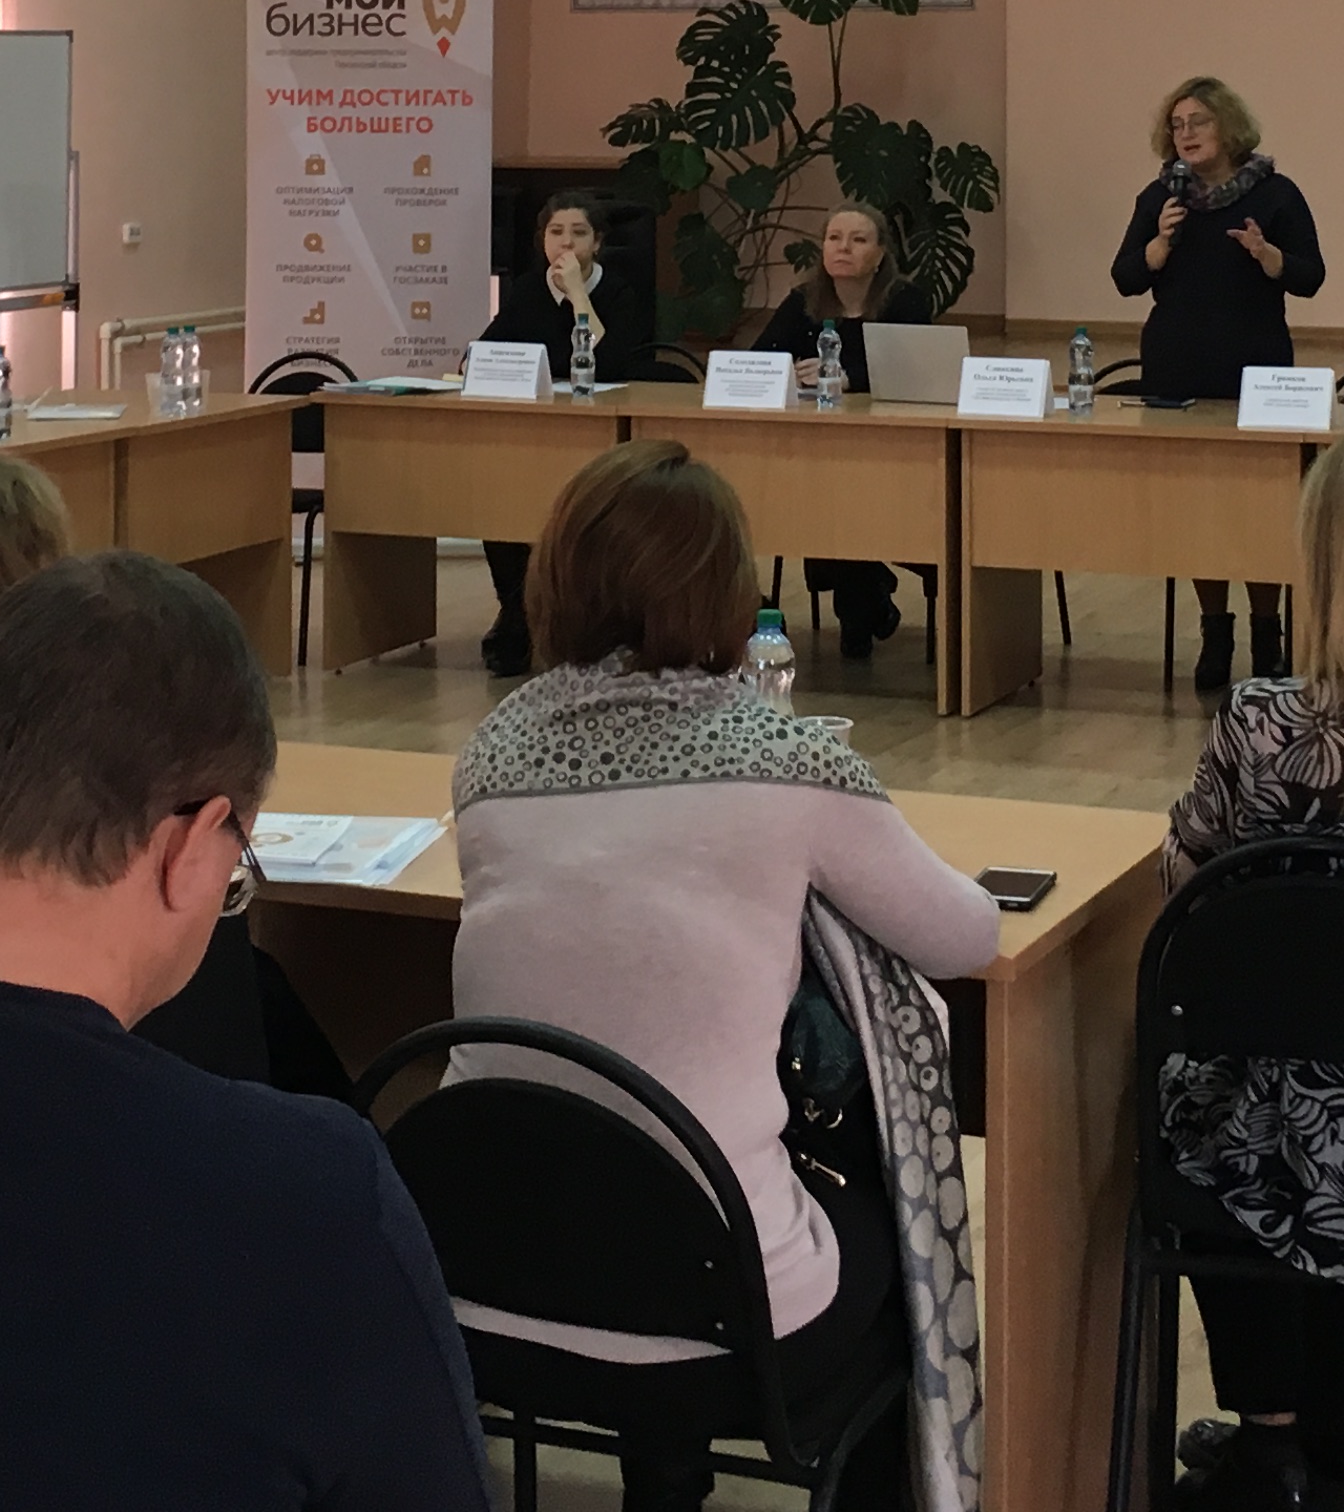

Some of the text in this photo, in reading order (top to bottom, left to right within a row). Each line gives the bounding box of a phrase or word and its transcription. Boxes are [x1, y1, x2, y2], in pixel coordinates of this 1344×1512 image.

[266, 2, 407, 37] бизнес
[266, 88, 474, 108] УЧИМ ДОСТИГАТЬ
[307, 116, 433, 134] БОЛЬШЕГО
